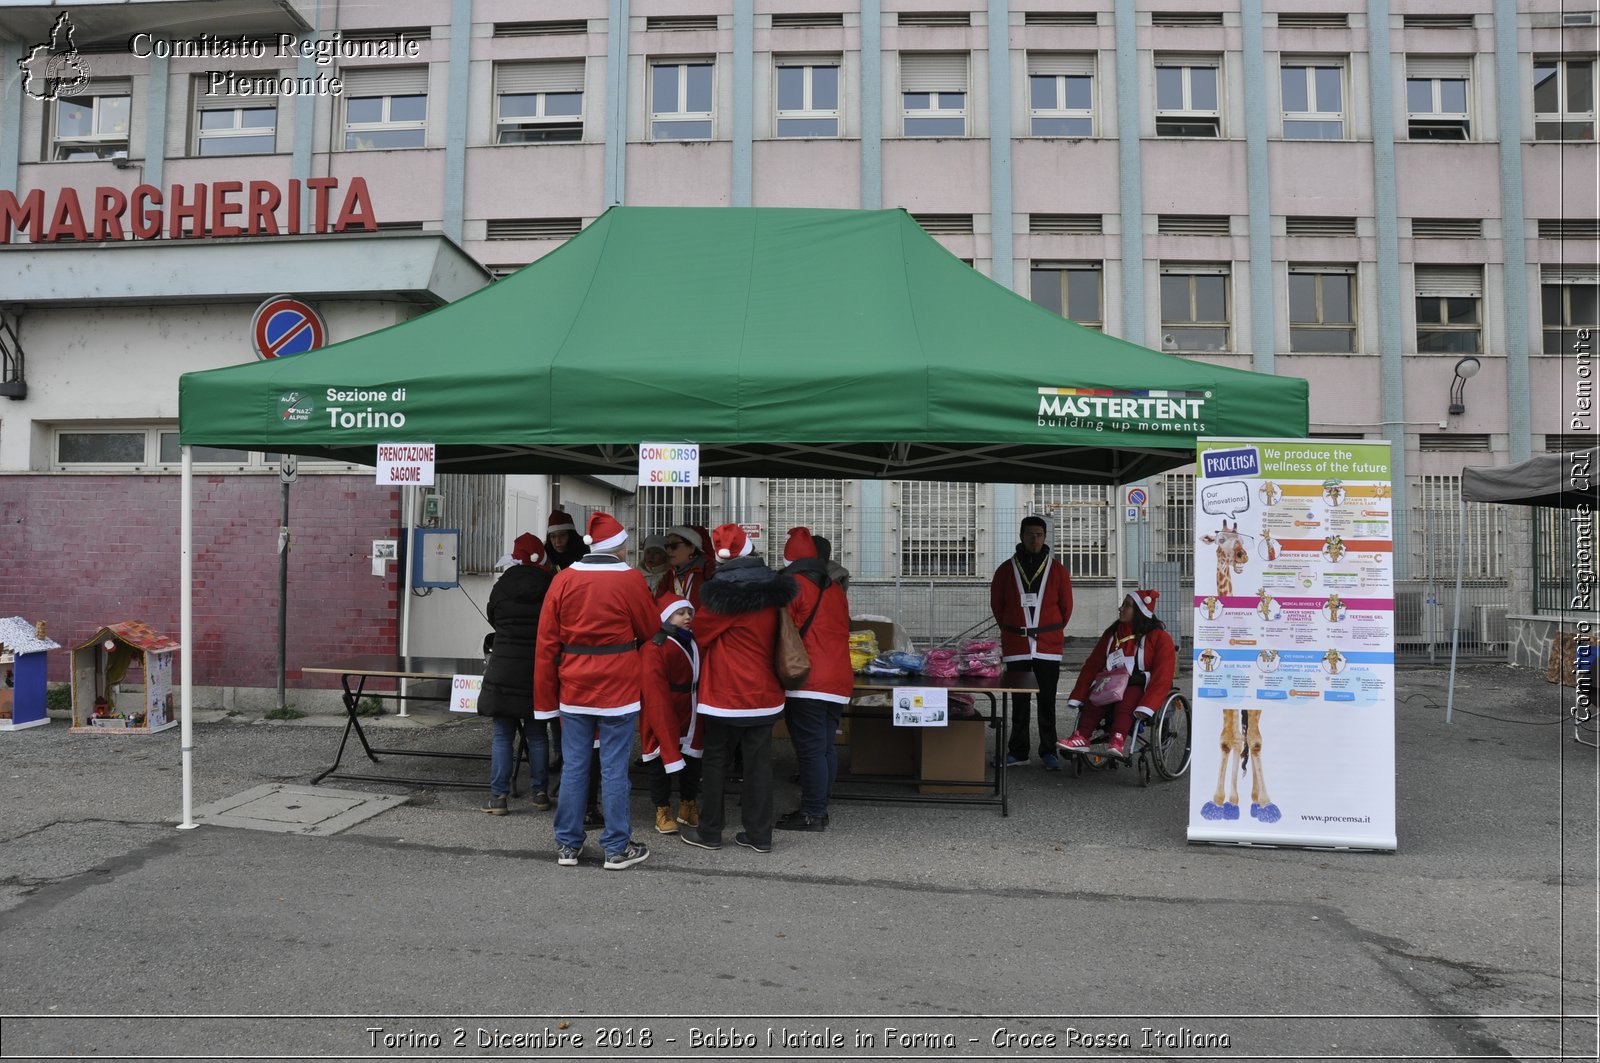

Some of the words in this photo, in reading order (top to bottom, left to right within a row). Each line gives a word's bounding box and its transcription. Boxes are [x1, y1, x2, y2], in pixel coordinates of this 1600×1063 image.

[0, 176, 378, 244] MARGHERITA
[326, 388, 387, 402] Sezione
[391, 388, 406, 402] di
[326, 407, 406, 429] Torino
[1037, 416, 1104, 432] building
[1112, 421, 1130, 432] up
[1138, 422, 1205, 432] moments
[379, 447, 434, 462] PRENOTAZIONE
[641, 448, 697, 461] CONCORSO
[1264, 449, 1281, 459] We
[1284, 449, 1331, 461] produce
[1333, 449, 1353, 460] the
[1207, 455, 1256, 473] PROCEMSA
[1264, 461, 1312, 472] wellness
[1315, 462, 1327, 472] of
[1330, 462, 1350, 473] the
[1352, 462, 1388, 473] future
[390, 467, 421, 482] SAGOME
[650, 470, 690, 483] SCUOLE
[1207, 496, 1247, 506] innovations!
[454, 678, 482, 690] CONCO
[459, 697, 477, 709] SCU
[1301, 814, 1371, 824] www.procemsa.it
